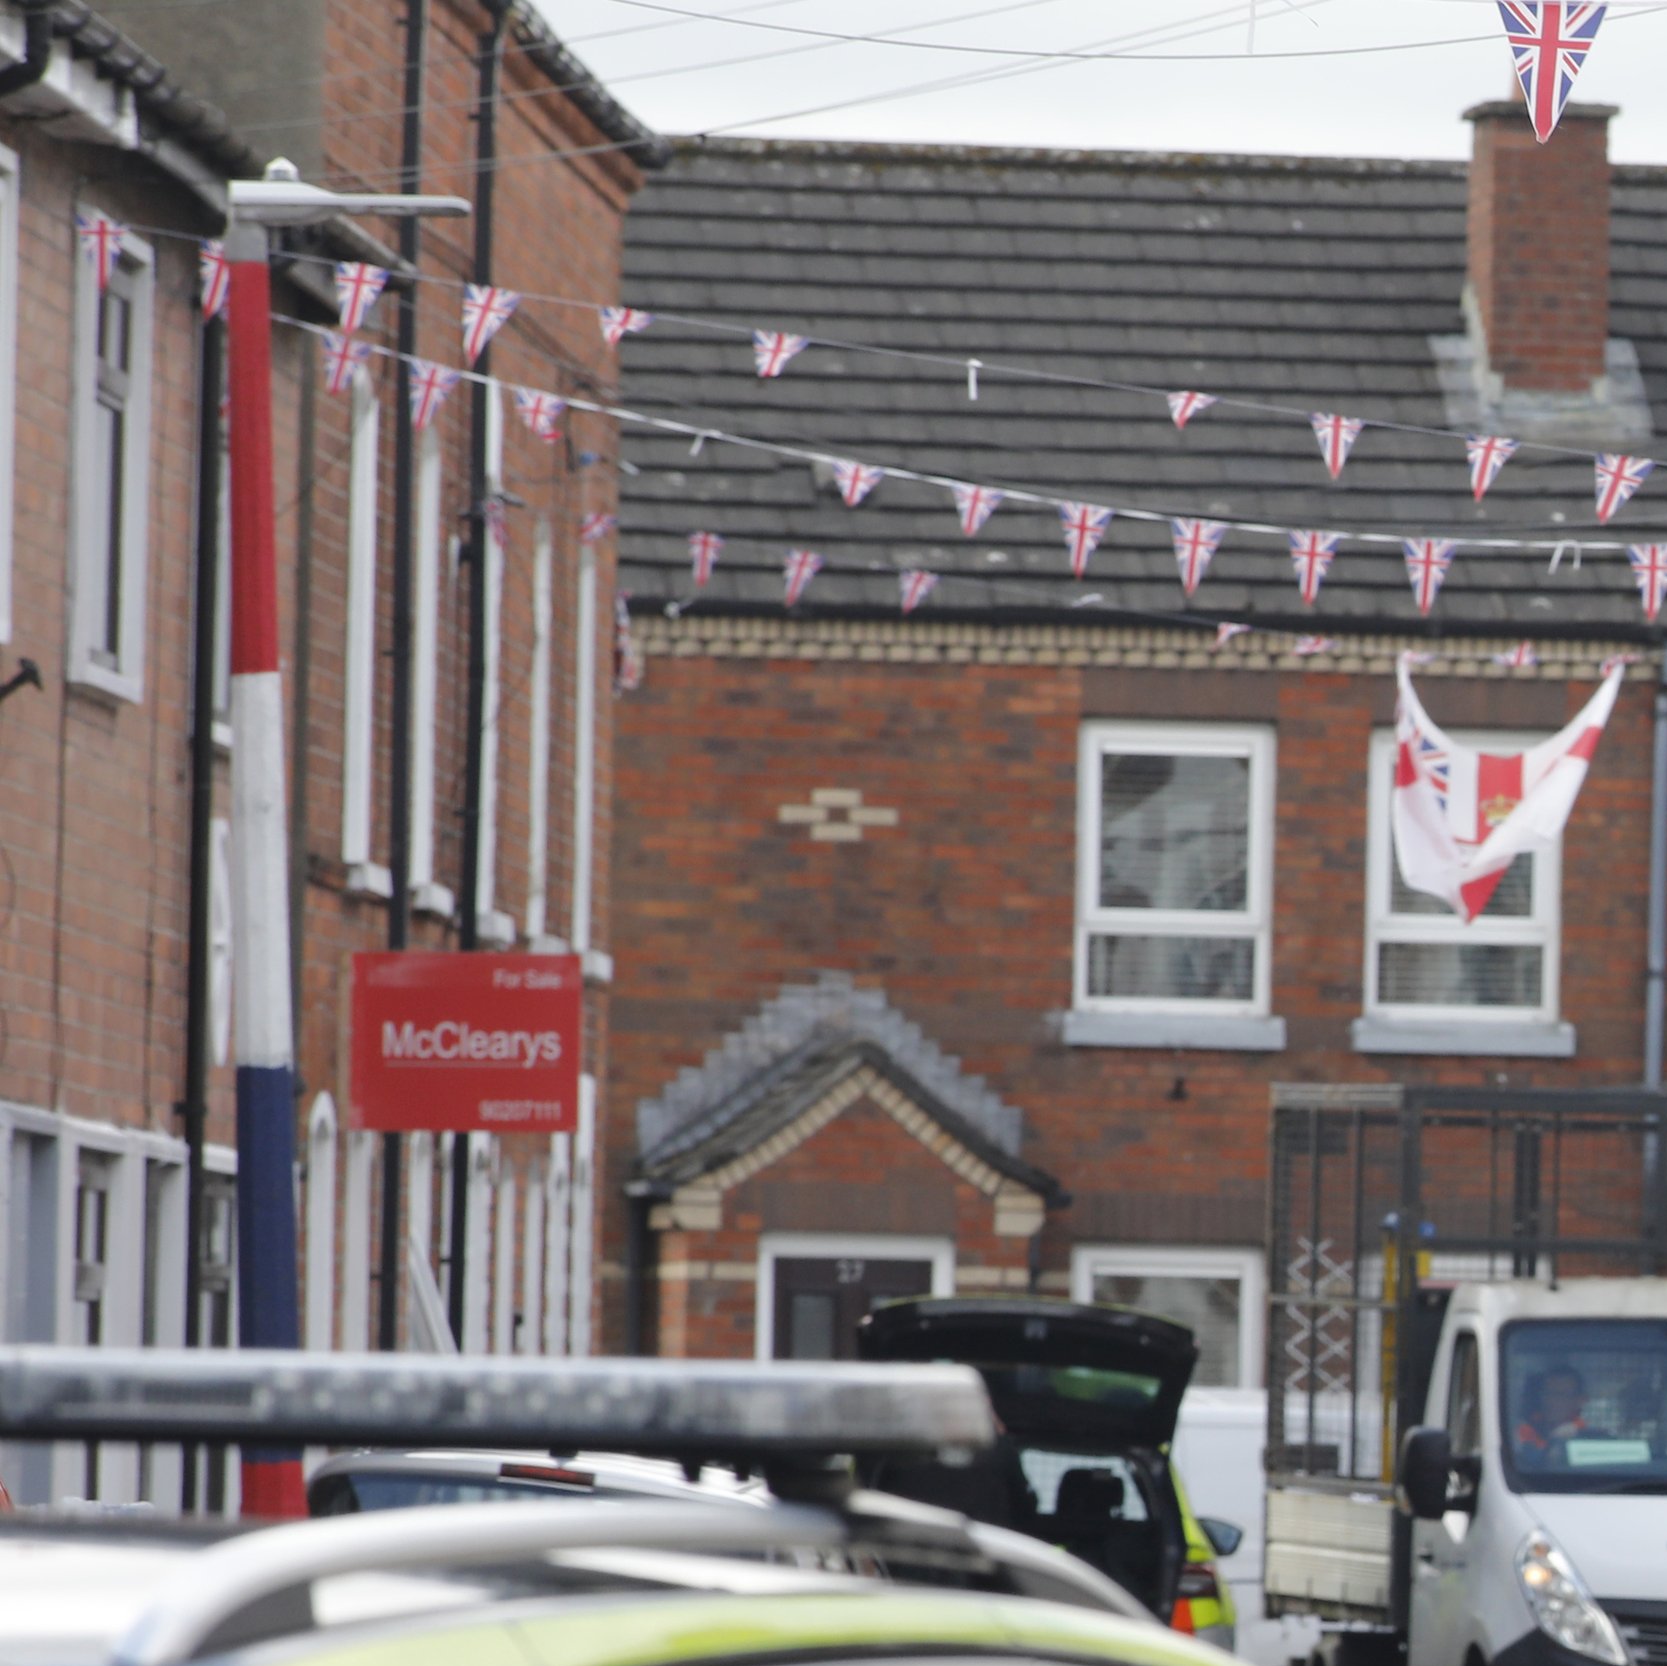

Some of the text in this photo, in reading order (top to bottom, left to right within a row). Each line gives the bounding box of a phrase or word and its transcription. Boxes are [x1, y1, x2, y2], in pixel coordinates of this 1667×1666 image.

[493, 968, 562, 990] For Sale
[382, 1020, 562, 1069] McClearys
